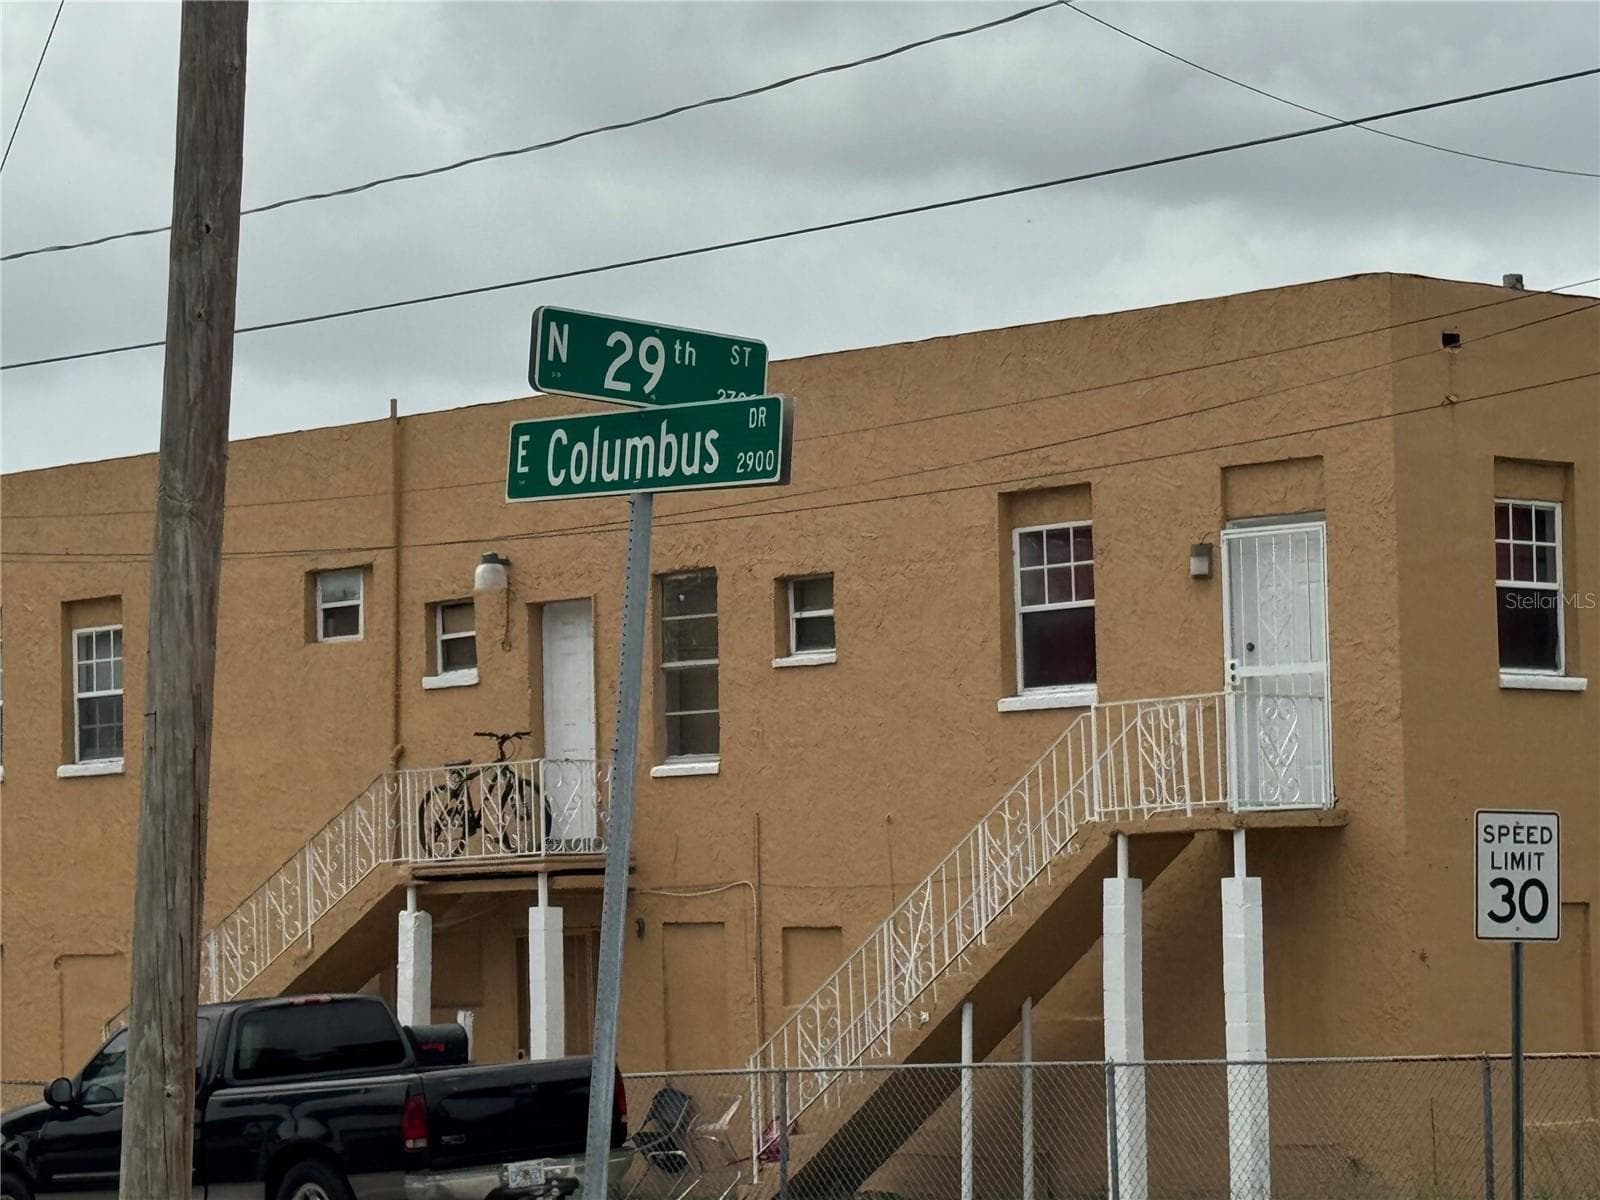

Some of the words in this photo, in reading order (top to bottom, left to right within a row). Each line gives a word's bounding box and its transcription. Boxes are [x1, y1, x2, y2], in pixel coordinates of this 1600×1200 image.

[547, 321, 569, 364] N
[730, 346, 753, 368] ST
[717, 388, 757, 402] 27
[516, 435, 531, 474] E
[547, 419, 720, 487] Columbus
[748, 406, 767, 429] DR
[736, 449, 775, 474] 2900
[1483, 824, 1553, 845] SPEED
[1490, 850, 1545, 871] LIMIT
[1487, 877, 1549, 924] 30
